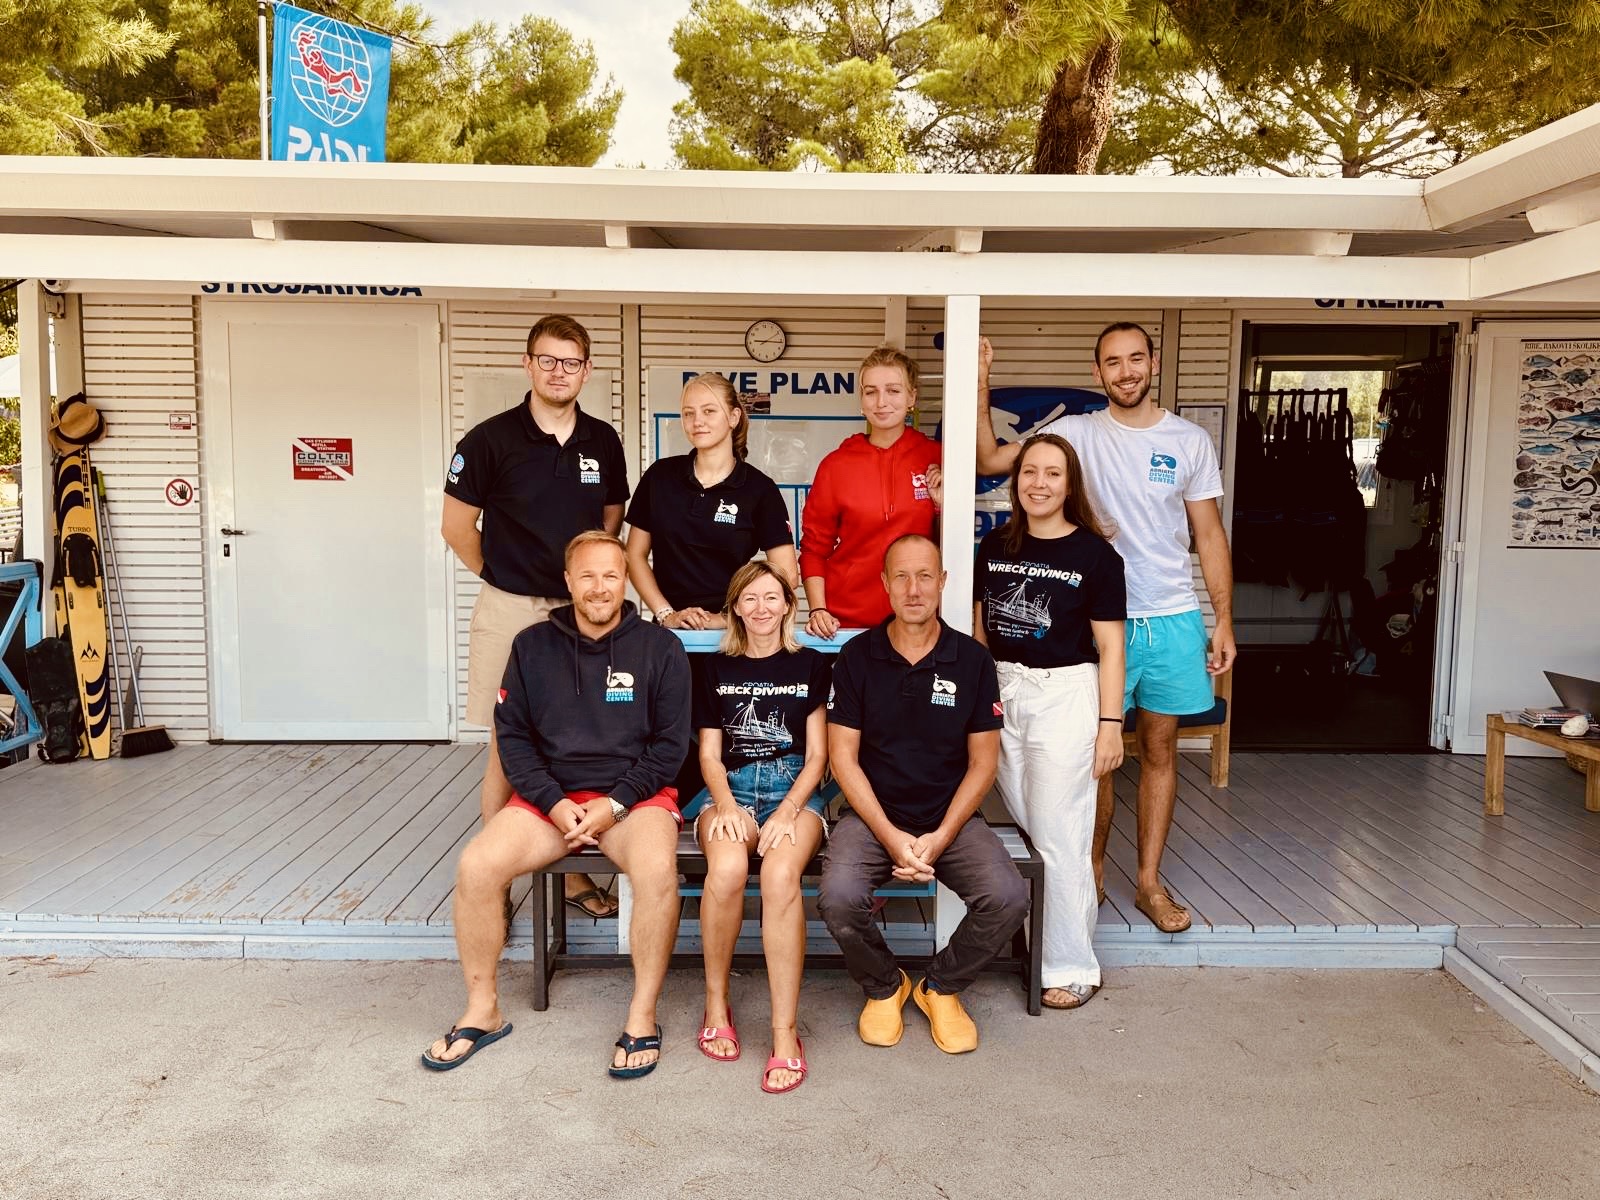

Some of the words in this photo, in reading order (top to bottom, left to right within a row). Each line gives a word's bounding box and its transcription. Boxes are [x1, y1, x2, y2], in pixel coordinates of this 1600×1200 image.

[770, 373, 855, 394] PLAN
[81, 445, 91, 509] MESLE
[988, 562, 1027, 575] WRECK
[1027, 567, 1071, 581] DIVING
[752, 686, 796, 695] DIVING
